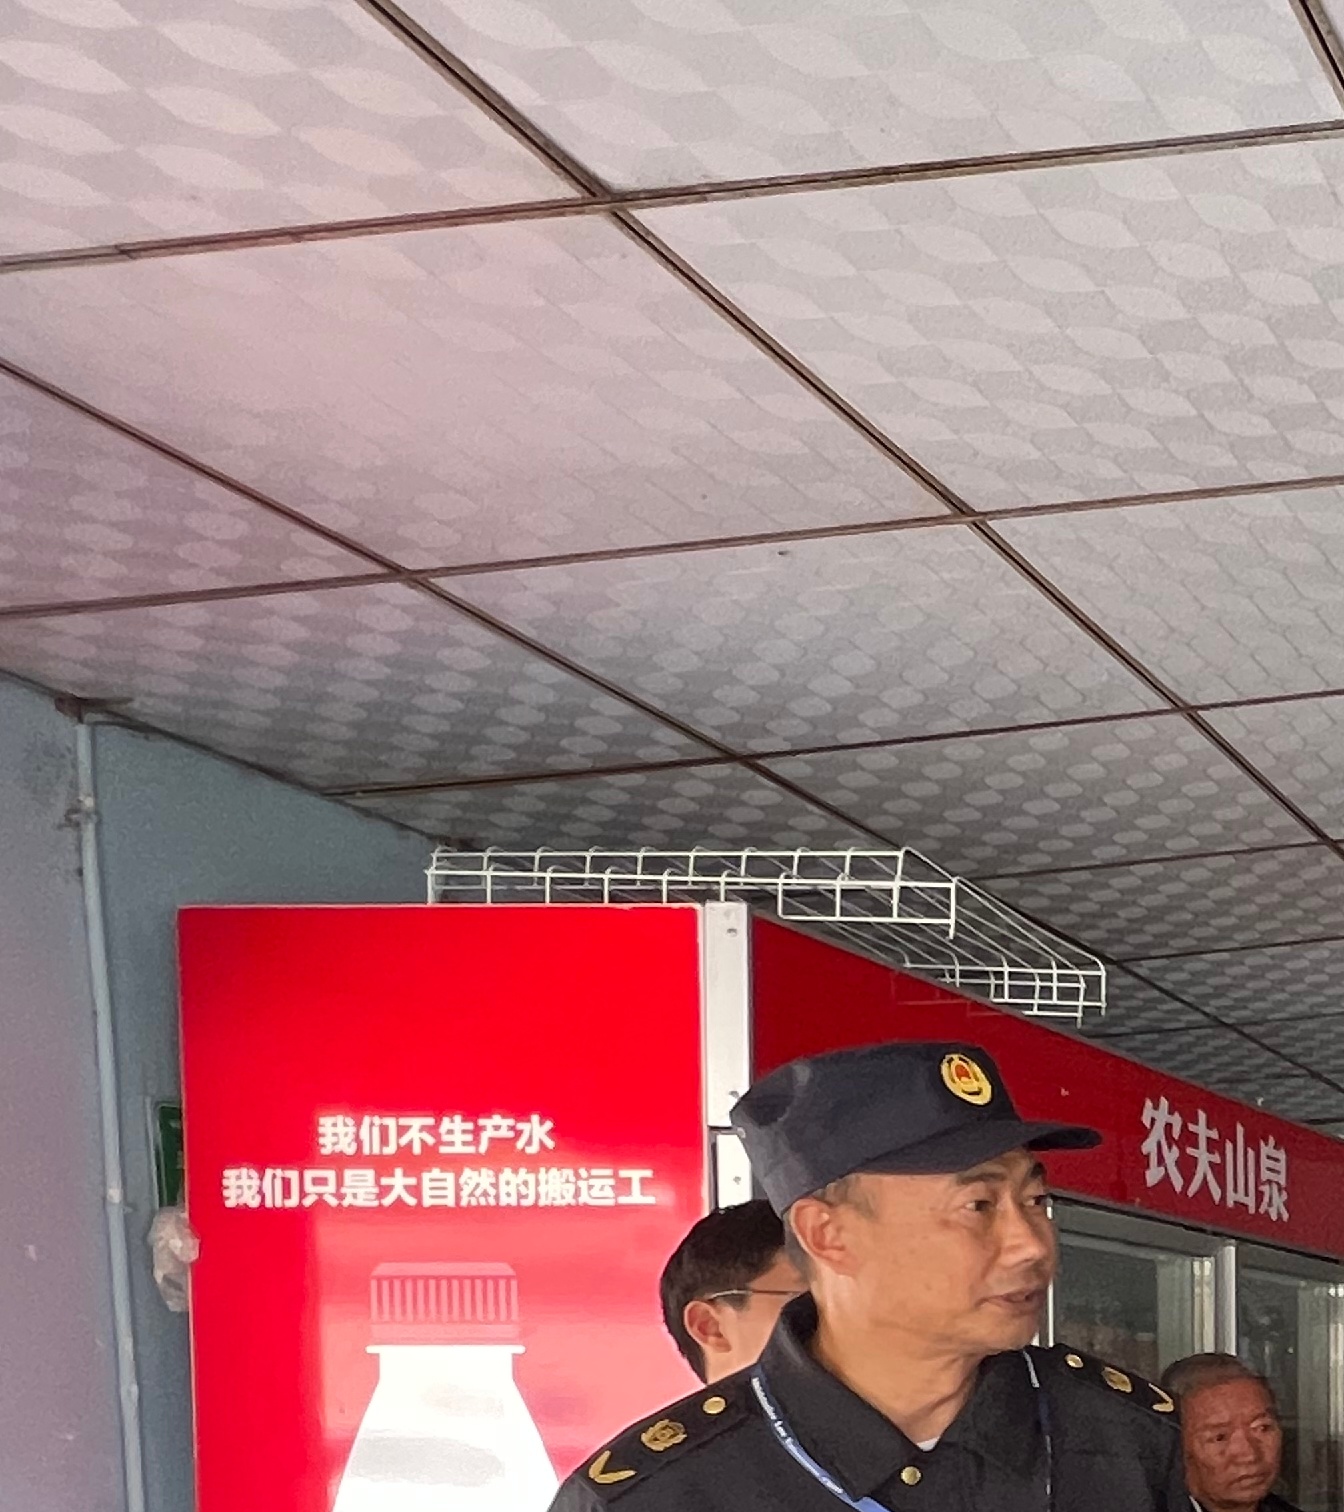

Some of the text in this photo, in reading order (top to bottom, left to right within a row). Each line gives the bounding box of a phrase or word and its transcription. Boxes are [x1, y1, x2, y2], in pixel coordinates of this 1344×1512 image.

[317, 1114, 556, 1157] 我们不生产水
[1141, 1096, 1289, 1222] 农夫山泉
[221, 1168, 656, 1209] 我们只是大自然的搬运工
